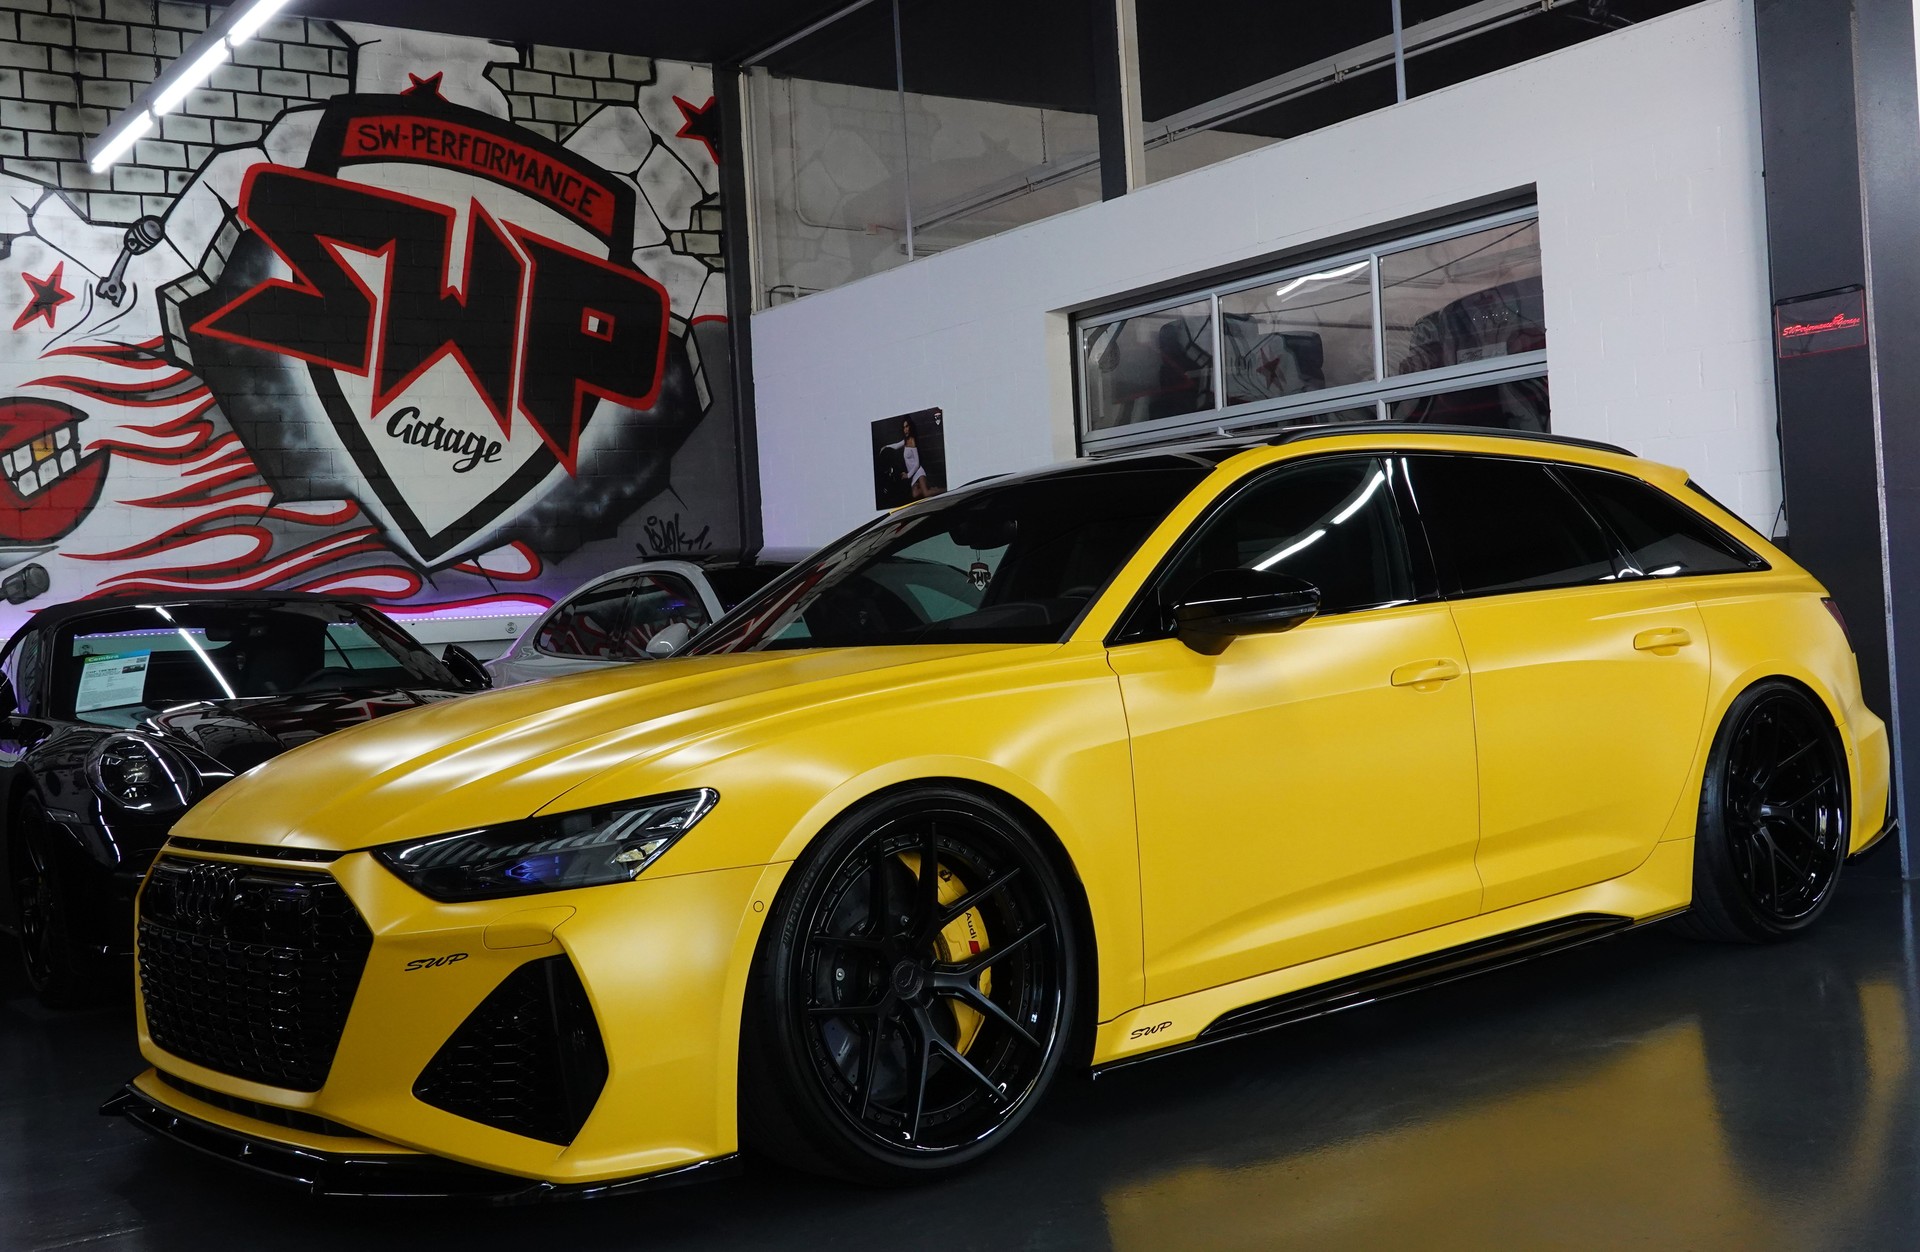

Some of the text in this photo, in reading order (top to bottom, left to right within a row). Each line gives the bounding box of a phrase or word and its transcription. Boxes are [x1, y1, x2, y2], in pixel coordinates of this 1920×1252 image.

[358, 124, 600, 218] SW-PERFORMANCE
[190, 162, 670, 479] SWP
[386, 406, 502, 474] Garage
[965, 912, 978, 939] Audi
[404, 952, 469, 972] SWP
[1130, 1021, 1173, 1040] SWP
